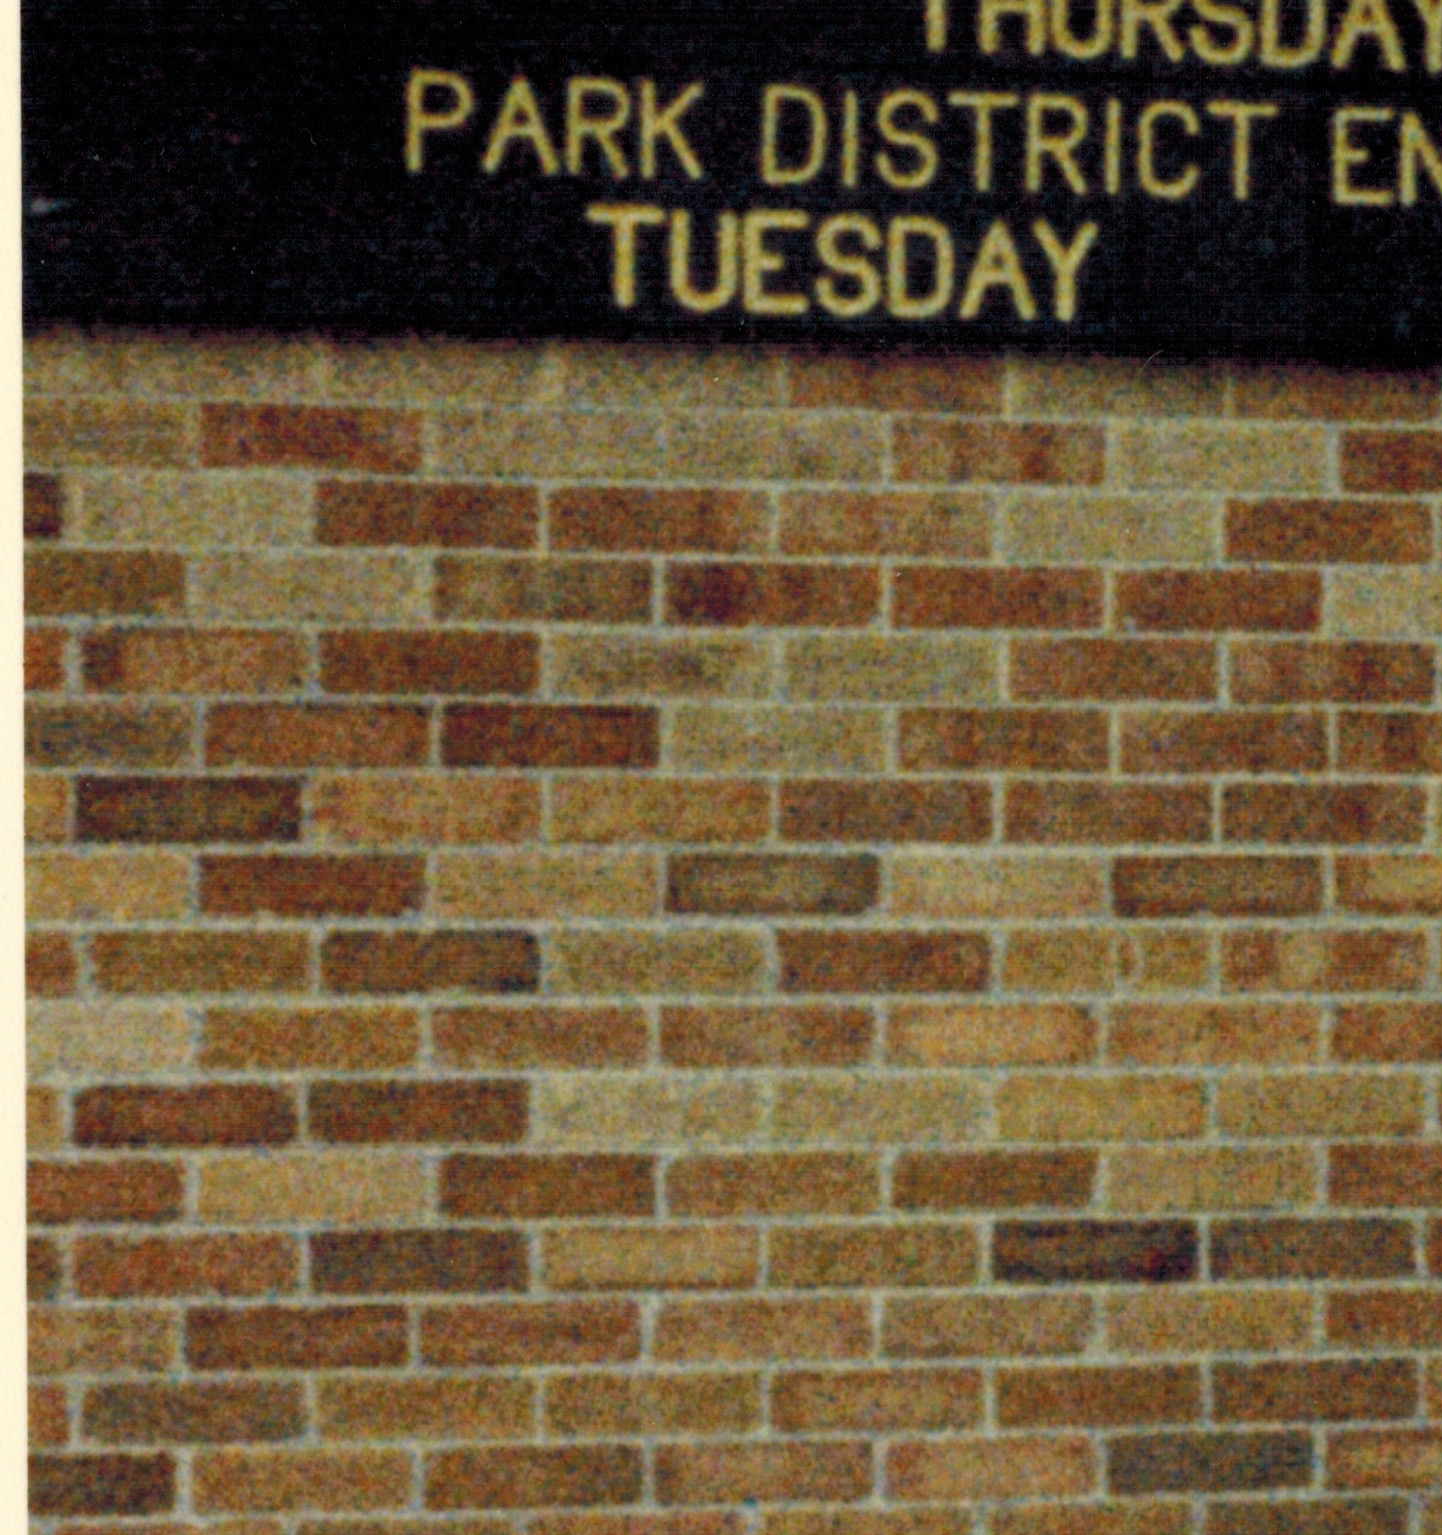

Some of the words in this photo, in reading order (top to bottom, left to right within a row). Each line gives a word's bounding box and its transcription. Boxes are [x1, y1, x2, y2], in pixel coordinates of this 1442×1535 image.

[404, 68, 704, 180] PARK
[759, 82, 1279, 202] DISTRICT
[585, 202, 1099, 323] TUESDAY
